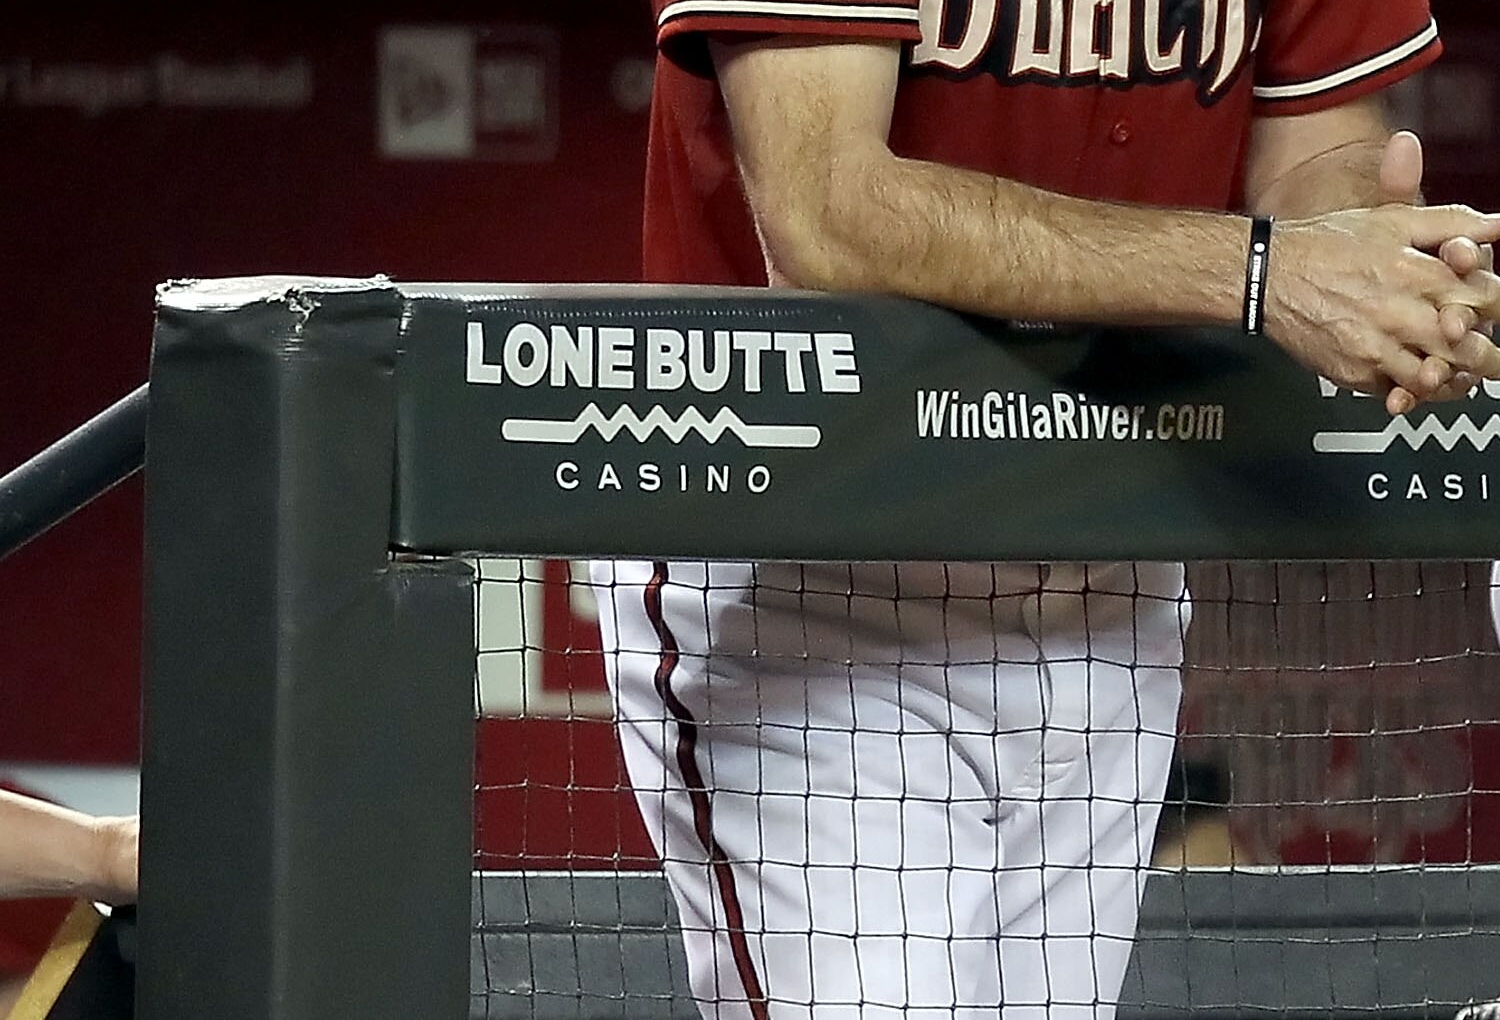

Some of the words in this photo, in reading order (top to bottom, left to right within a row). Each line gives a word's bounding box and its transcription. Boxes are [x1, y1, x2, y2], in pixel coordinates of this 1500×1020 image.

[466, 321, 636, 390] LONE
[645, 328, 861, 394] BUTTE
[915, 389, 1226, 441] WinGilaRiver.com
[555, 461, 772, 493] CASINO
